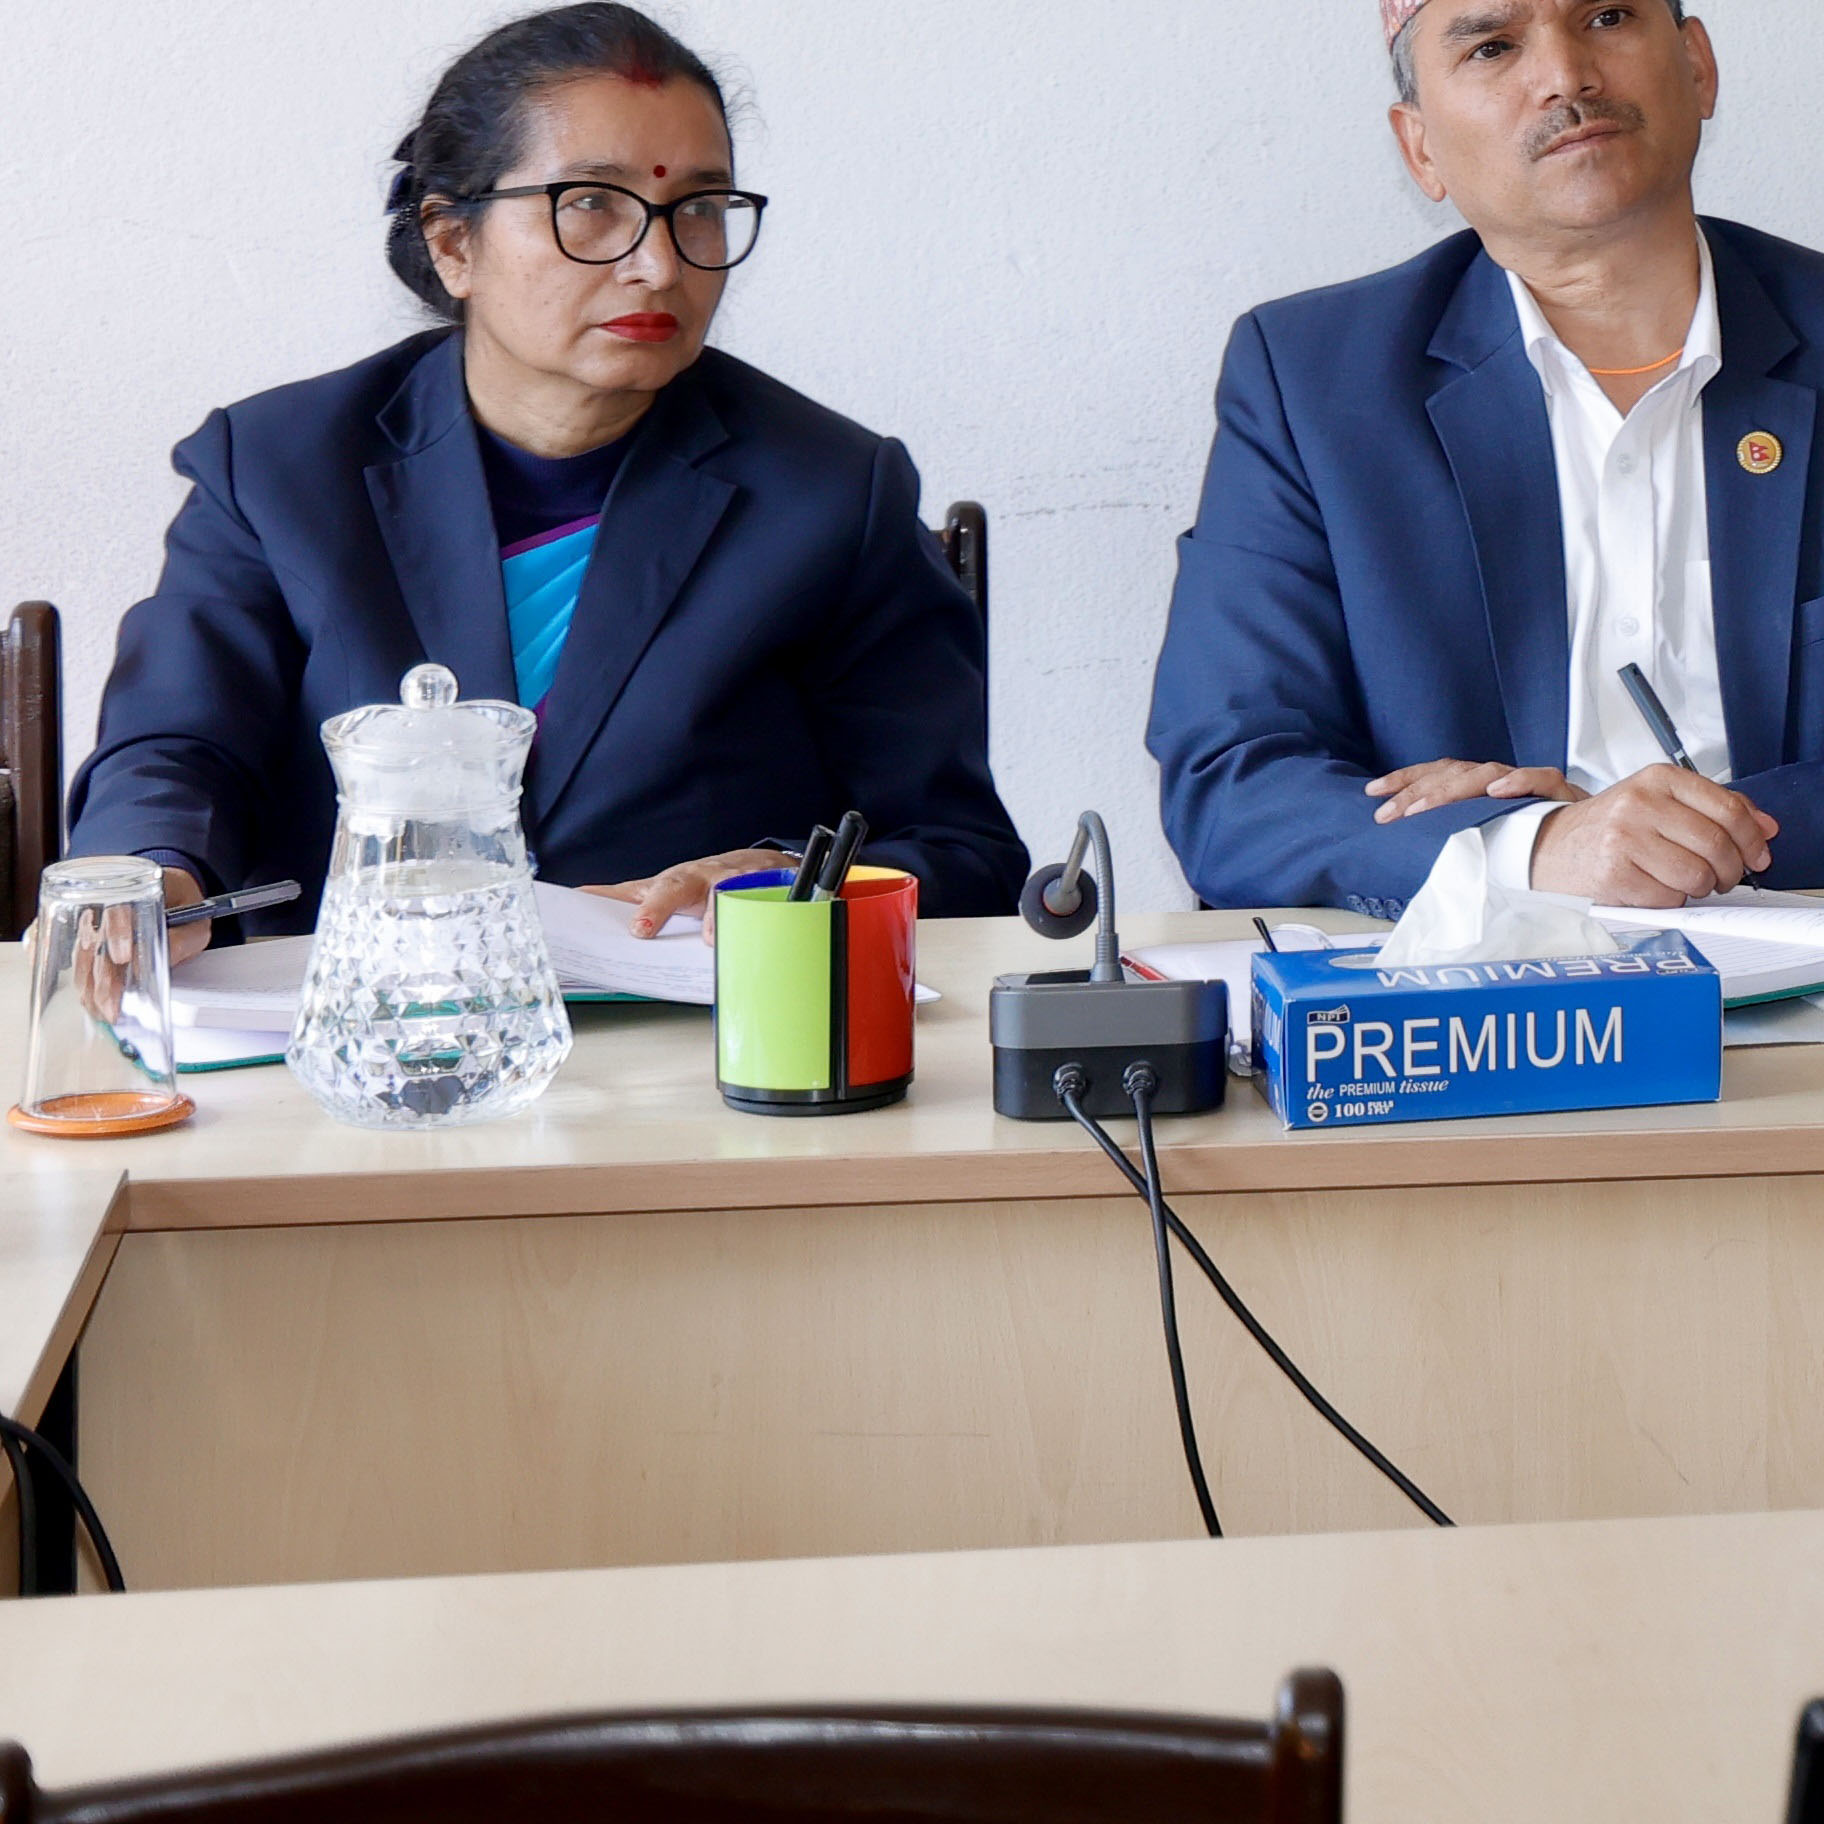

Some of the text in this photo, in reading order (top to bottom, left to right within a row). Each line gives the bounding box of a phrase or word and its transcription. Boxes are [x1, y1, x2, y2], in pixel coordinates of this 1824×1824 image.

[1377, 956, 1696, 987] PREMIUM
[1316, 1012, 1341, 1022] NPI
[1307, 1007, 1623, 1082] PREMIUM
[1307, 1079, 1450, 1100] the PREMIUM tissue
[1334, 1101, 1365, 1118] 100
